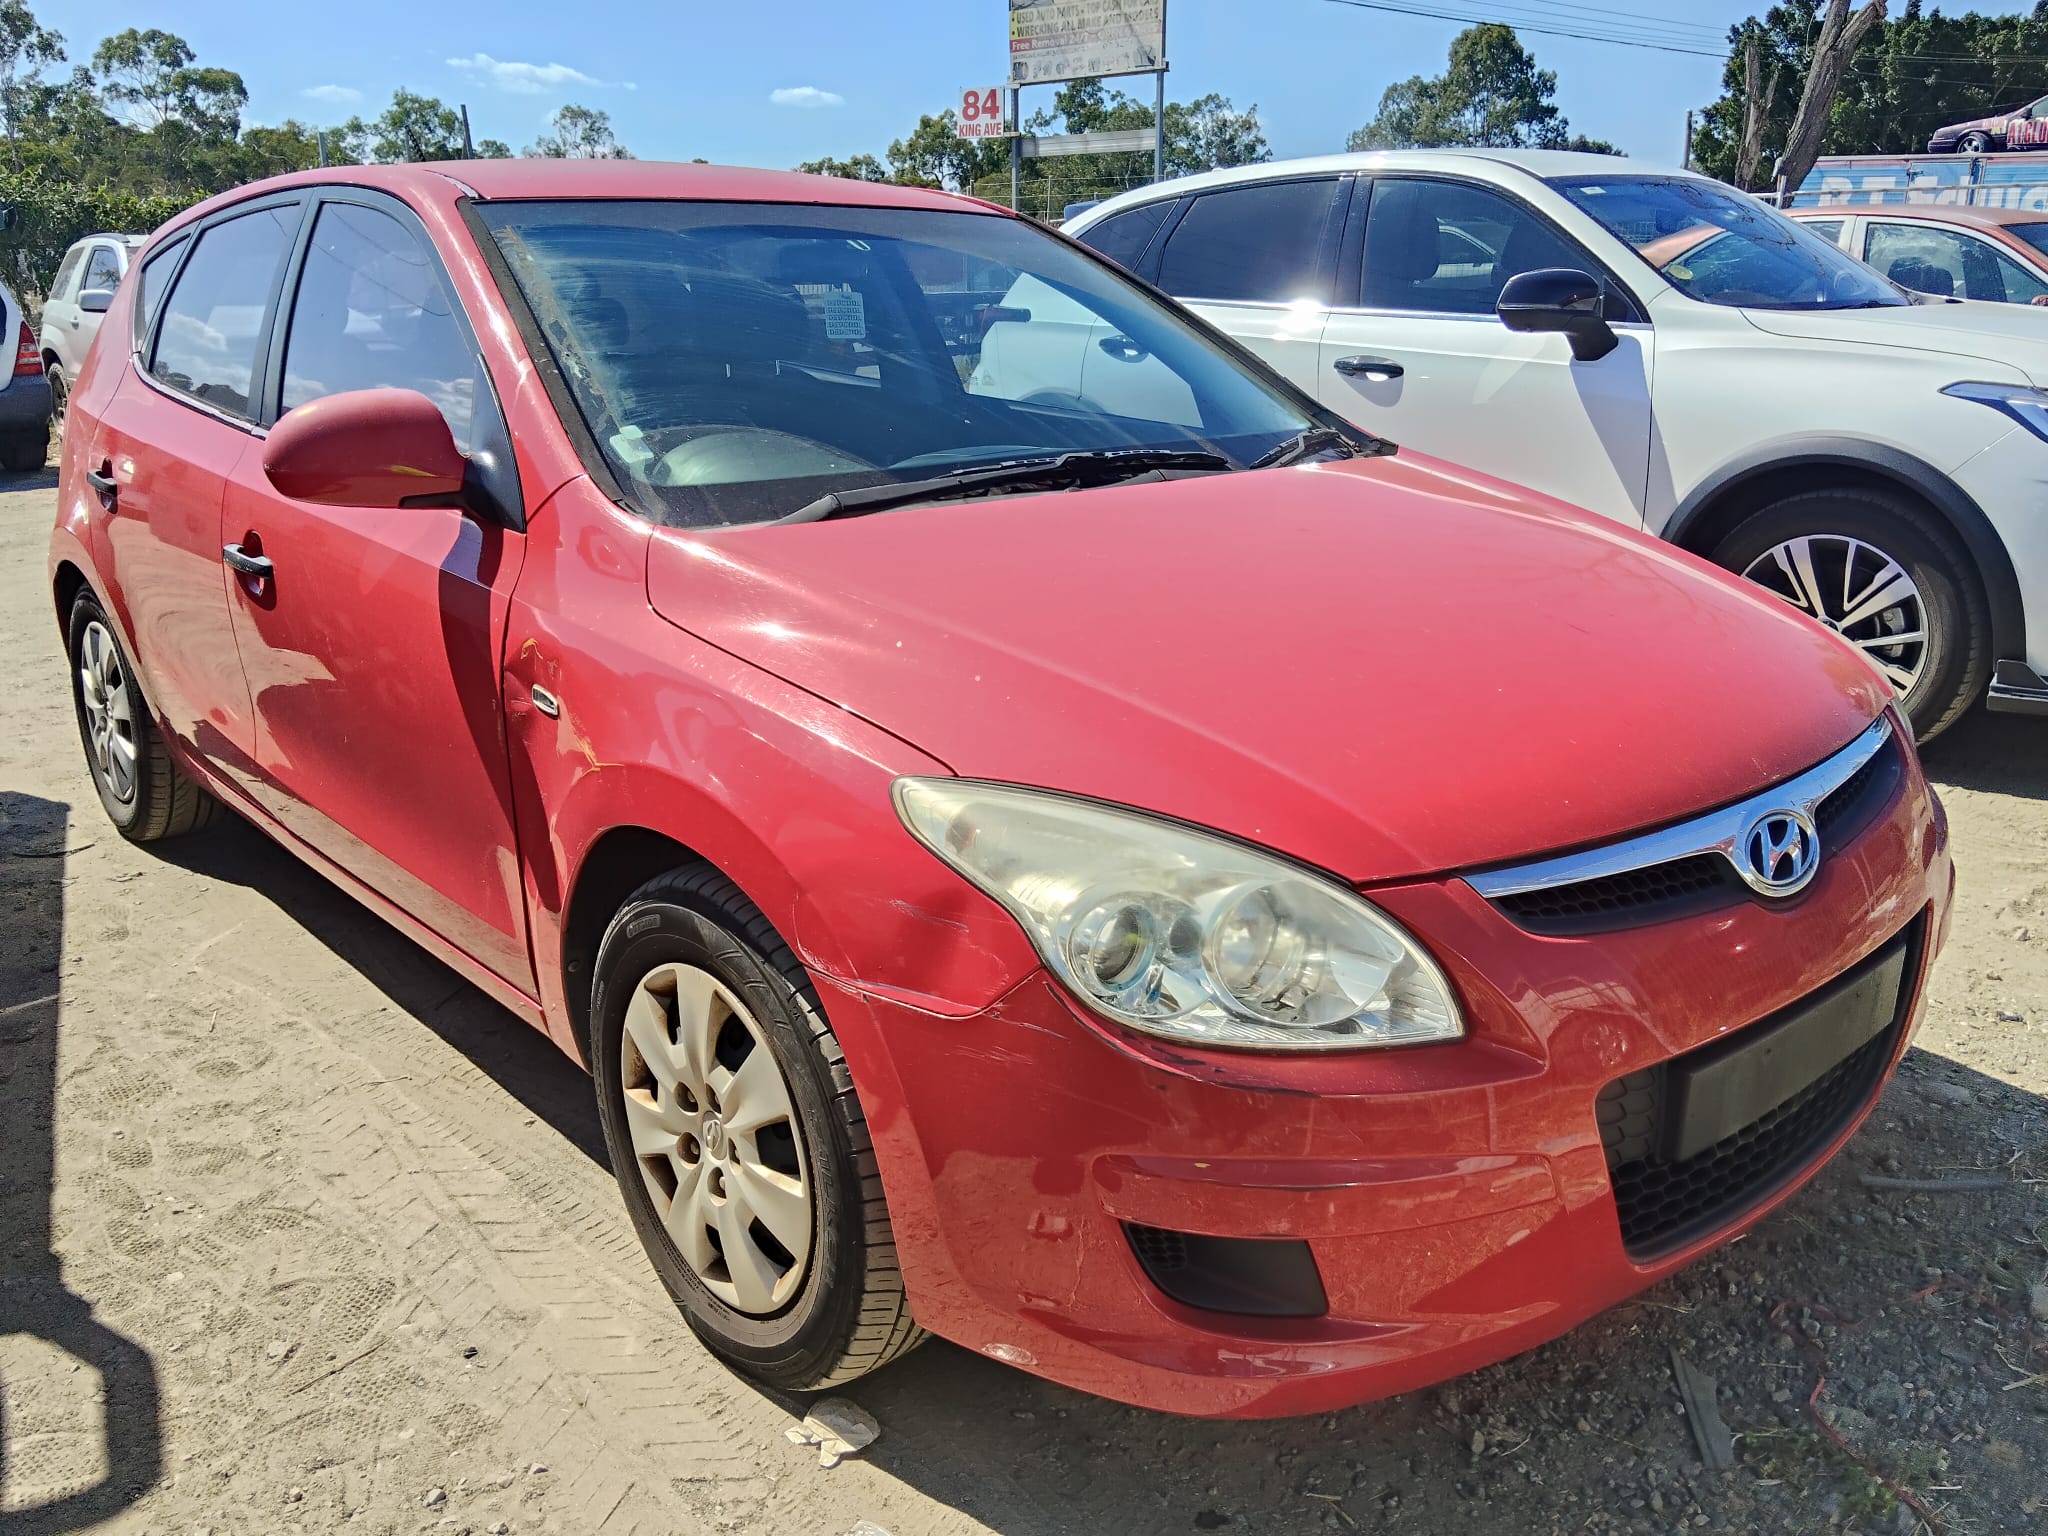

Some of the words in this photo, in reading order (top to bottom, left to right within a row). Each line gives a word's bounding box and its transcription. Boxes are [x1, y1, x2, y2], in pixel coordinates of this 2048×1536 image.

[1017, 11, 1034, 24] USED
[1036, 8, 1055, 22] AUTO
[1056, 5, 1080, 19] PARTS
[1017, 22, 1059, 38] WRECKING
[1012, 41, 1031, 52] Free
[1031, 35, 1068, 50] Removal
[962, 89, 1000, 121] 84
[958, 123, 982, 138] KING
[984, 122, 1003, 137] AVE
